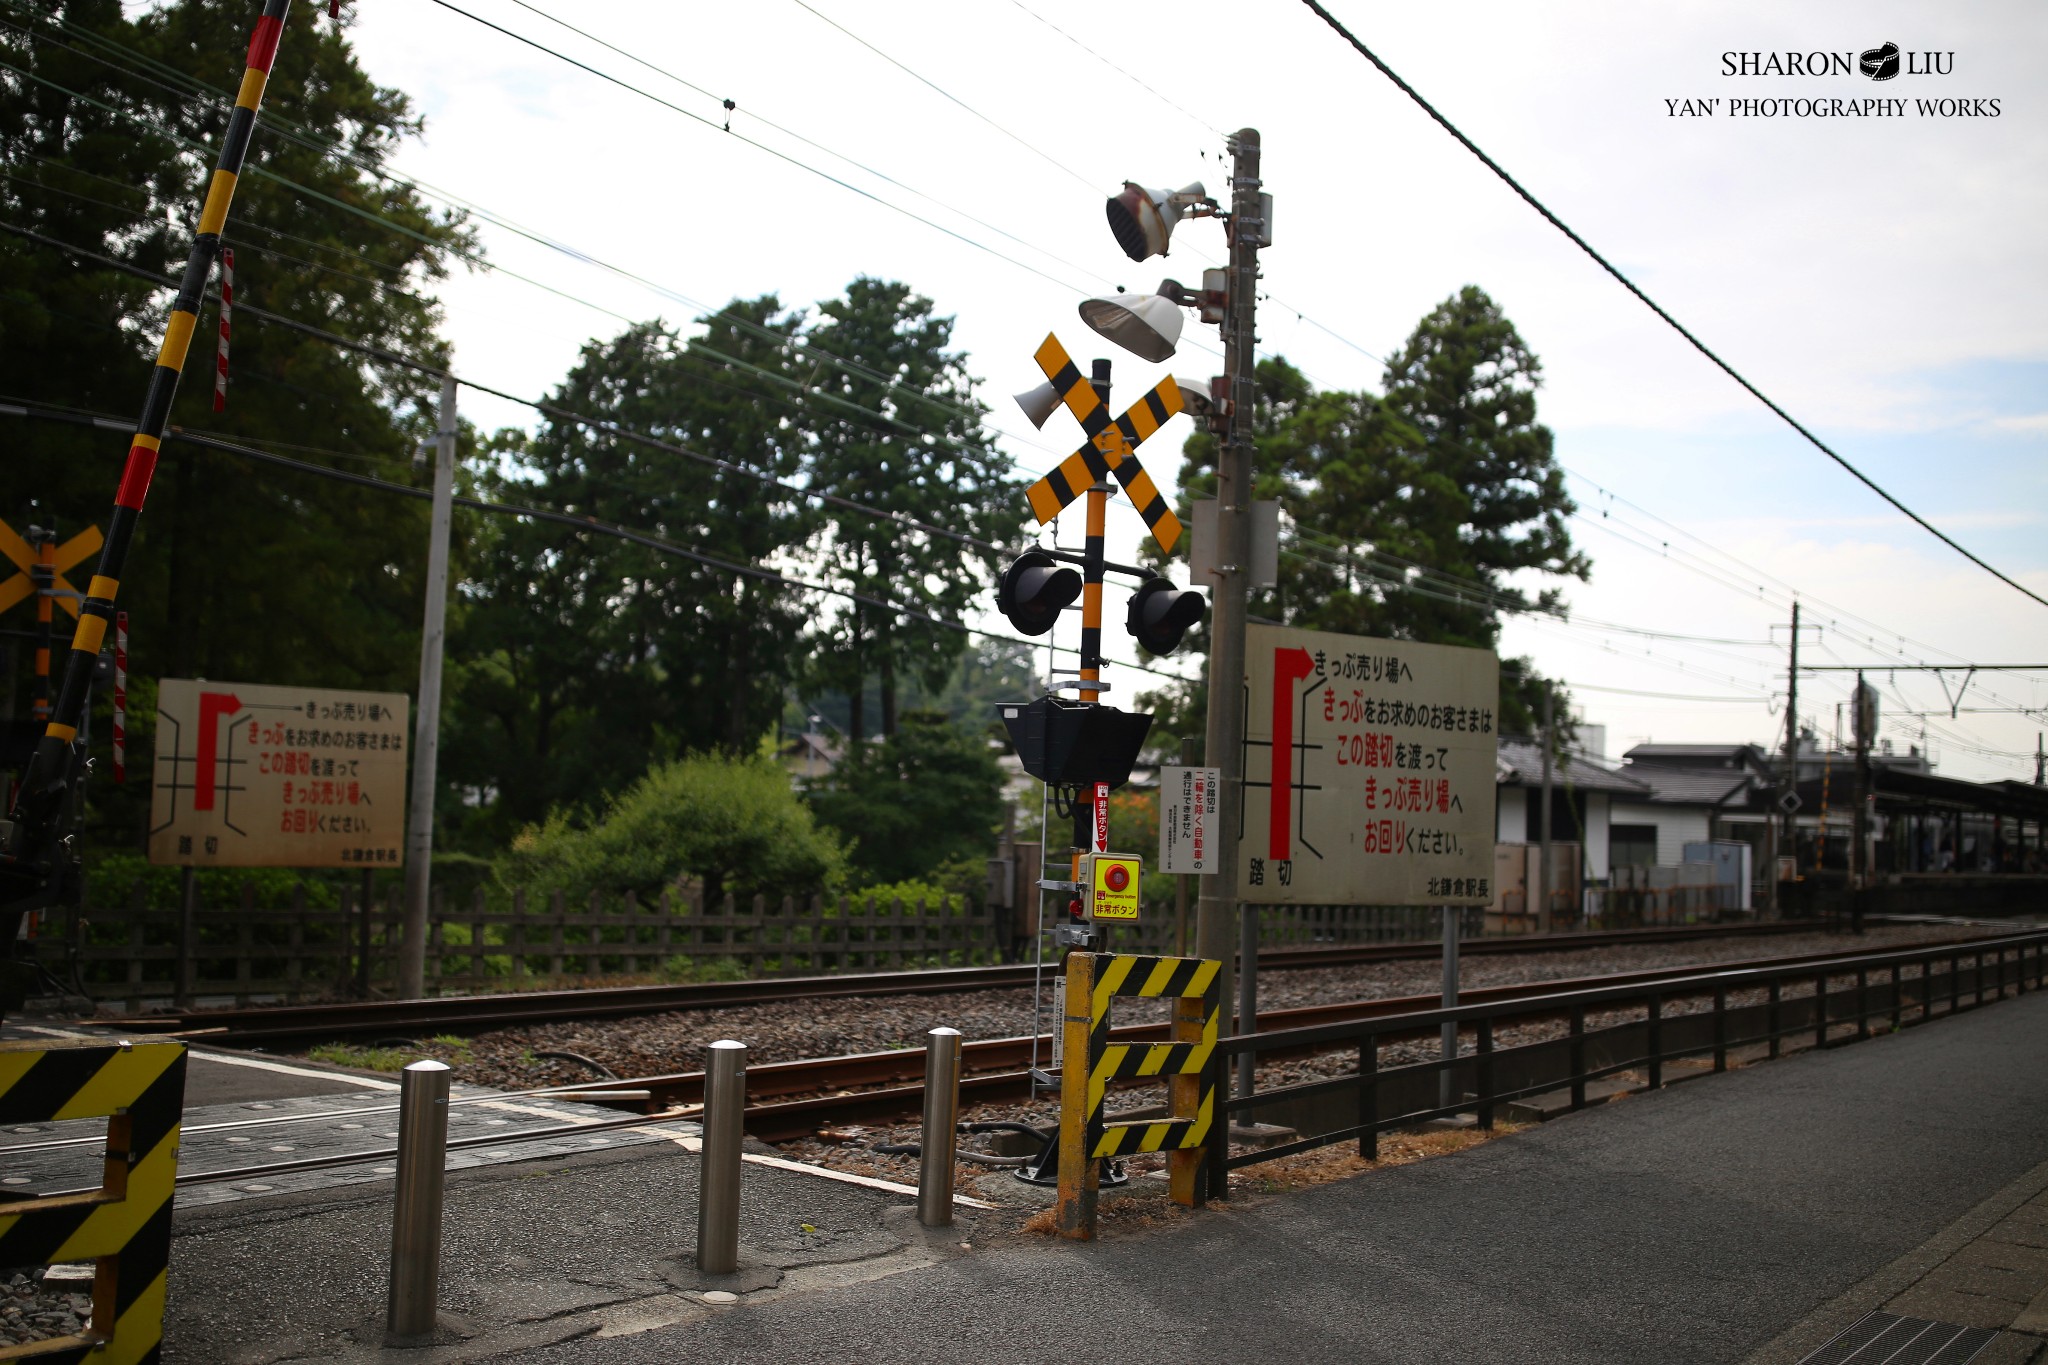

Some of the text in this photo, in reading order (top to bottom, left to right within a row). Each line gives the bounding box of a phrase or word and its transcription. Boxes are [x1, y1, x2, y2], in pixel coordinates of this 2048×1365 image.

[1315, 650, 1413, 684] きっぷ売り場へ
[1324, 686, 1492, 733] きっぷをお求めのお客さまは
[1337, 732, 1448, 772] この踏切を渡って
[1182, 771, 1192, 839] 通行はできません
[1207, 772, 1216, 814] この踏切は
[1365, 775, 1463, 814] きっぷ売り場へ
[1098, 800, 1107, 841] 非常ボタン
[1194, 771, 1205, 869] 二輪を除く自動車の
[1364, 818, 1464, 856] お回りください。
[1427, 876, 1489, 898] 北鎌倉駅長
[1096, 904, 1136, 915] 非常ボタン
